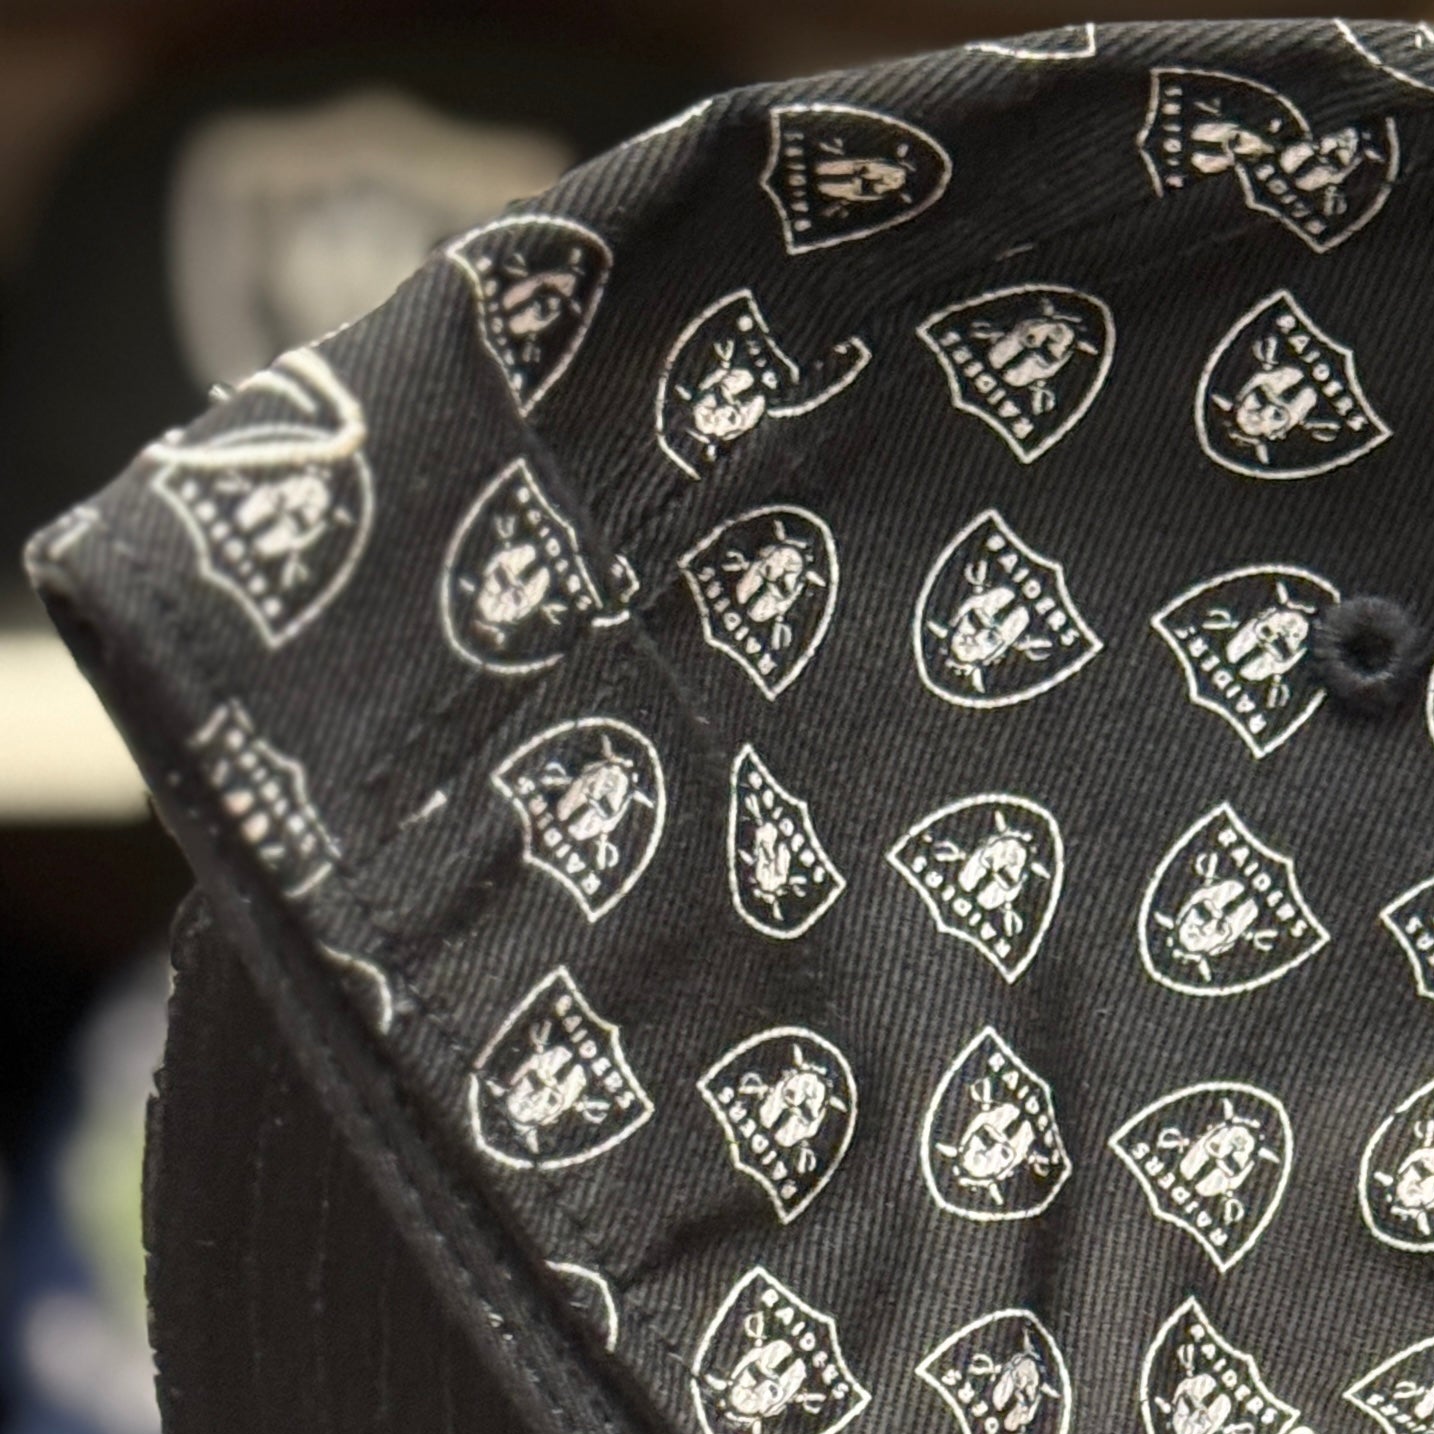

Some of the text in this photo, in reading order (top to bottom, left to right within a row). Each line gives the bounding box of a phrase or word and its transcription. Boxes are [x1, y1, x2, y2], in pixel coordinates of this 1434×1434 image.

[1277, 315, 1365, 431] RAIDERS
[986, 533, 1080, 647] RAIDERS
[1174, 626, 1267, 734] RAIDERS
[912, 856, 1010, 957] RAIDERS
[1218, 828, 1307, 937] RAIDERS
[1133, 1143, 1228, 1247] RAIDERS
[762, 1288, 849, 1398] RAIDERS
[1189, 1323, 1278, 1424] RAIDERS
